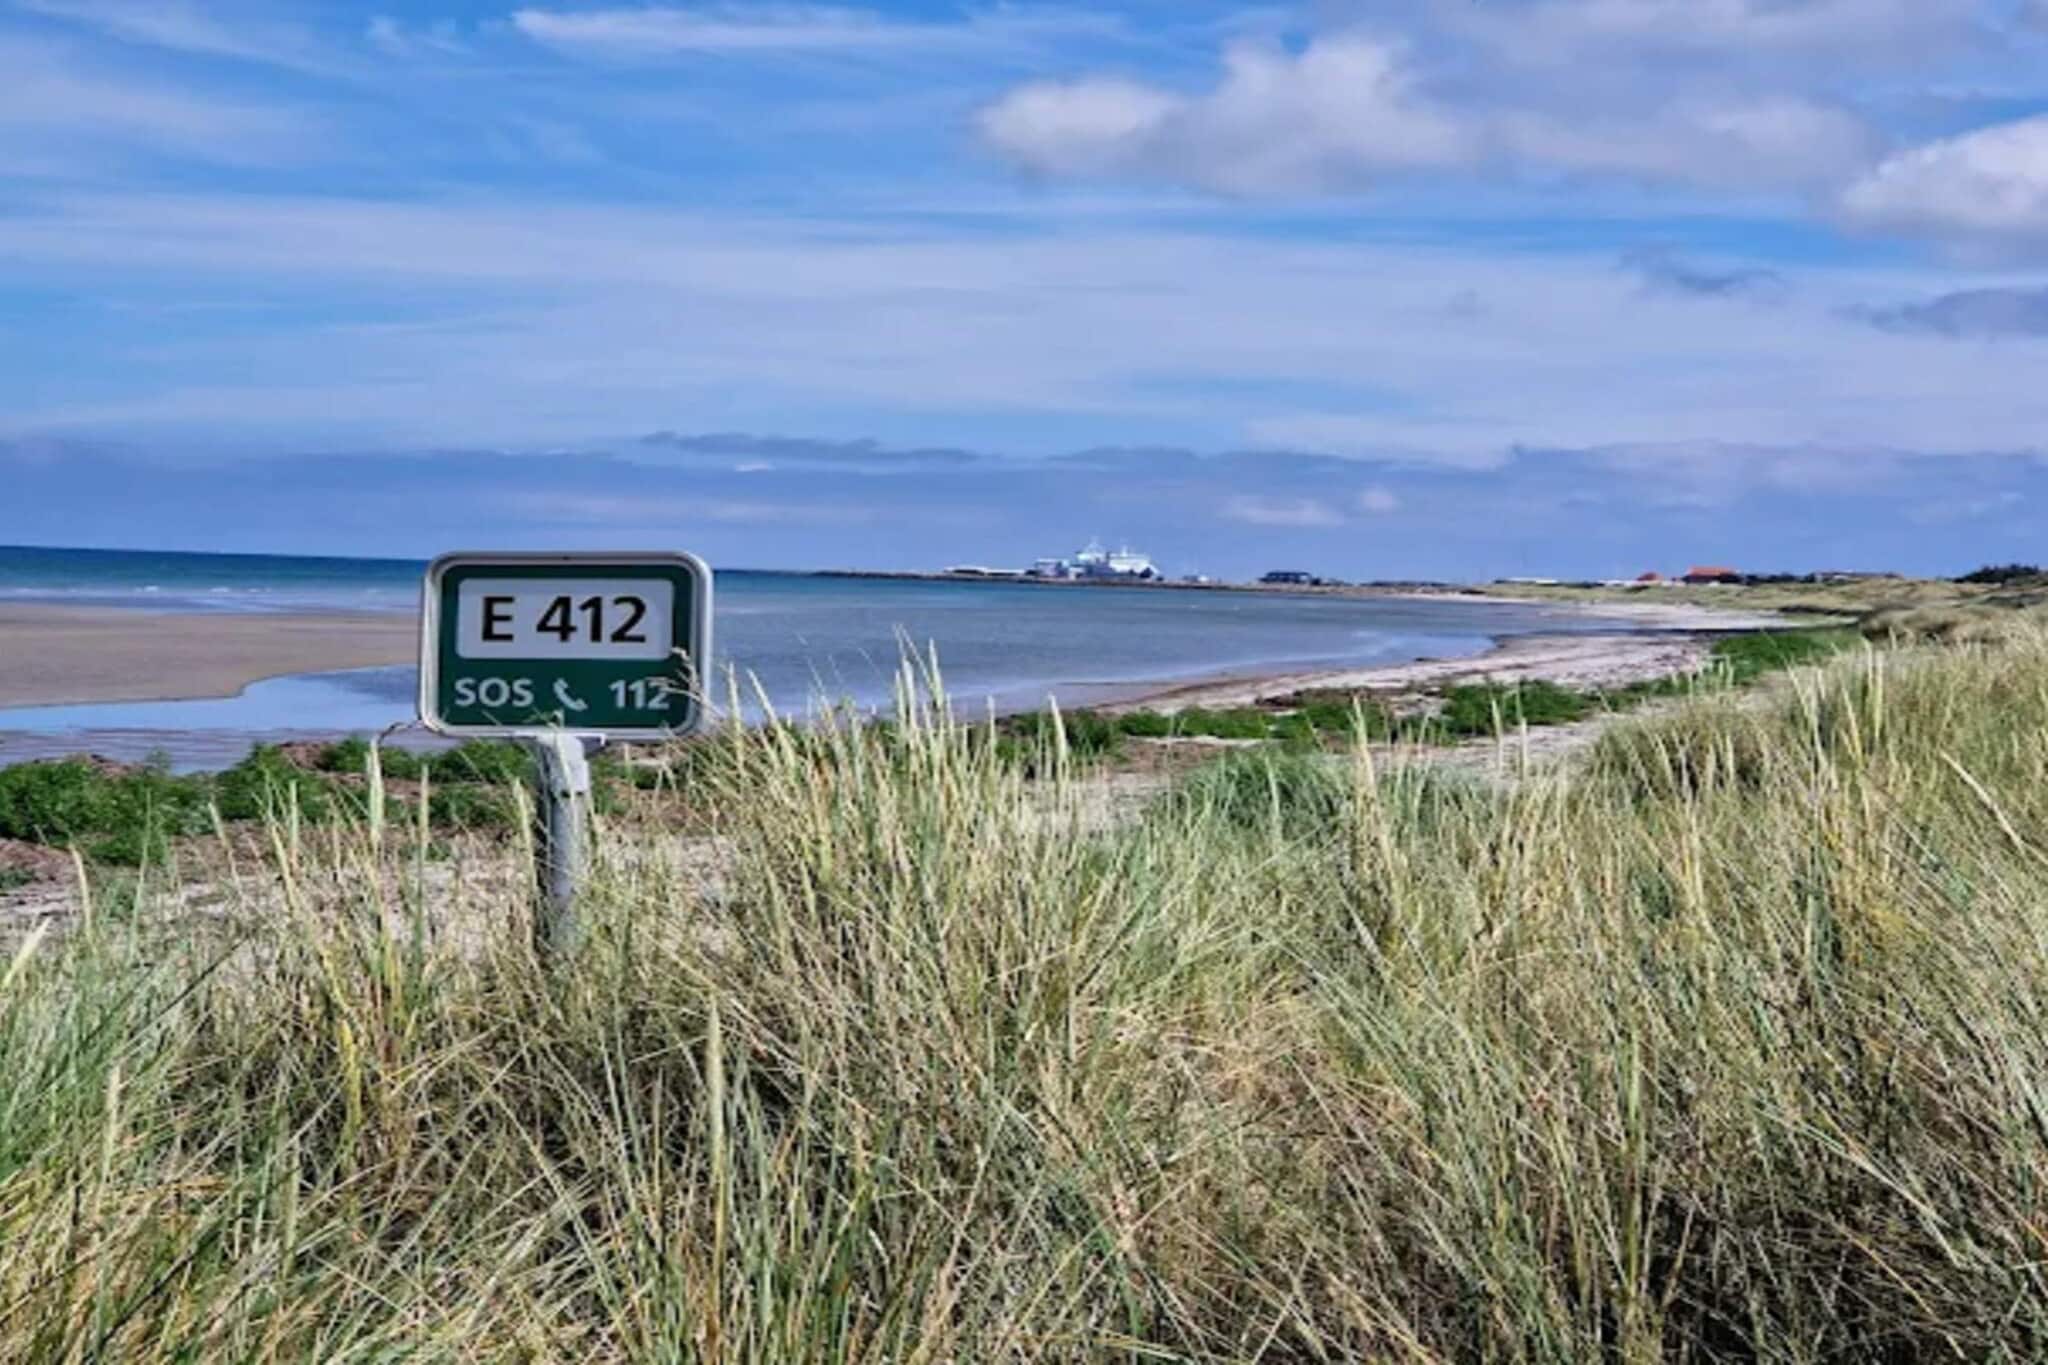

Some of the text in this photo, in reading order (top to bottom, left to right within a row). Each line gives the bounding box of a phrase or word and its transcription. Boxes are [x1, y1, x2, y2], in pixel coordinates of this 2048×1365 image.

[482, 596, 647, 643] E 412
[454, 677, 670, 710] SOS 112
